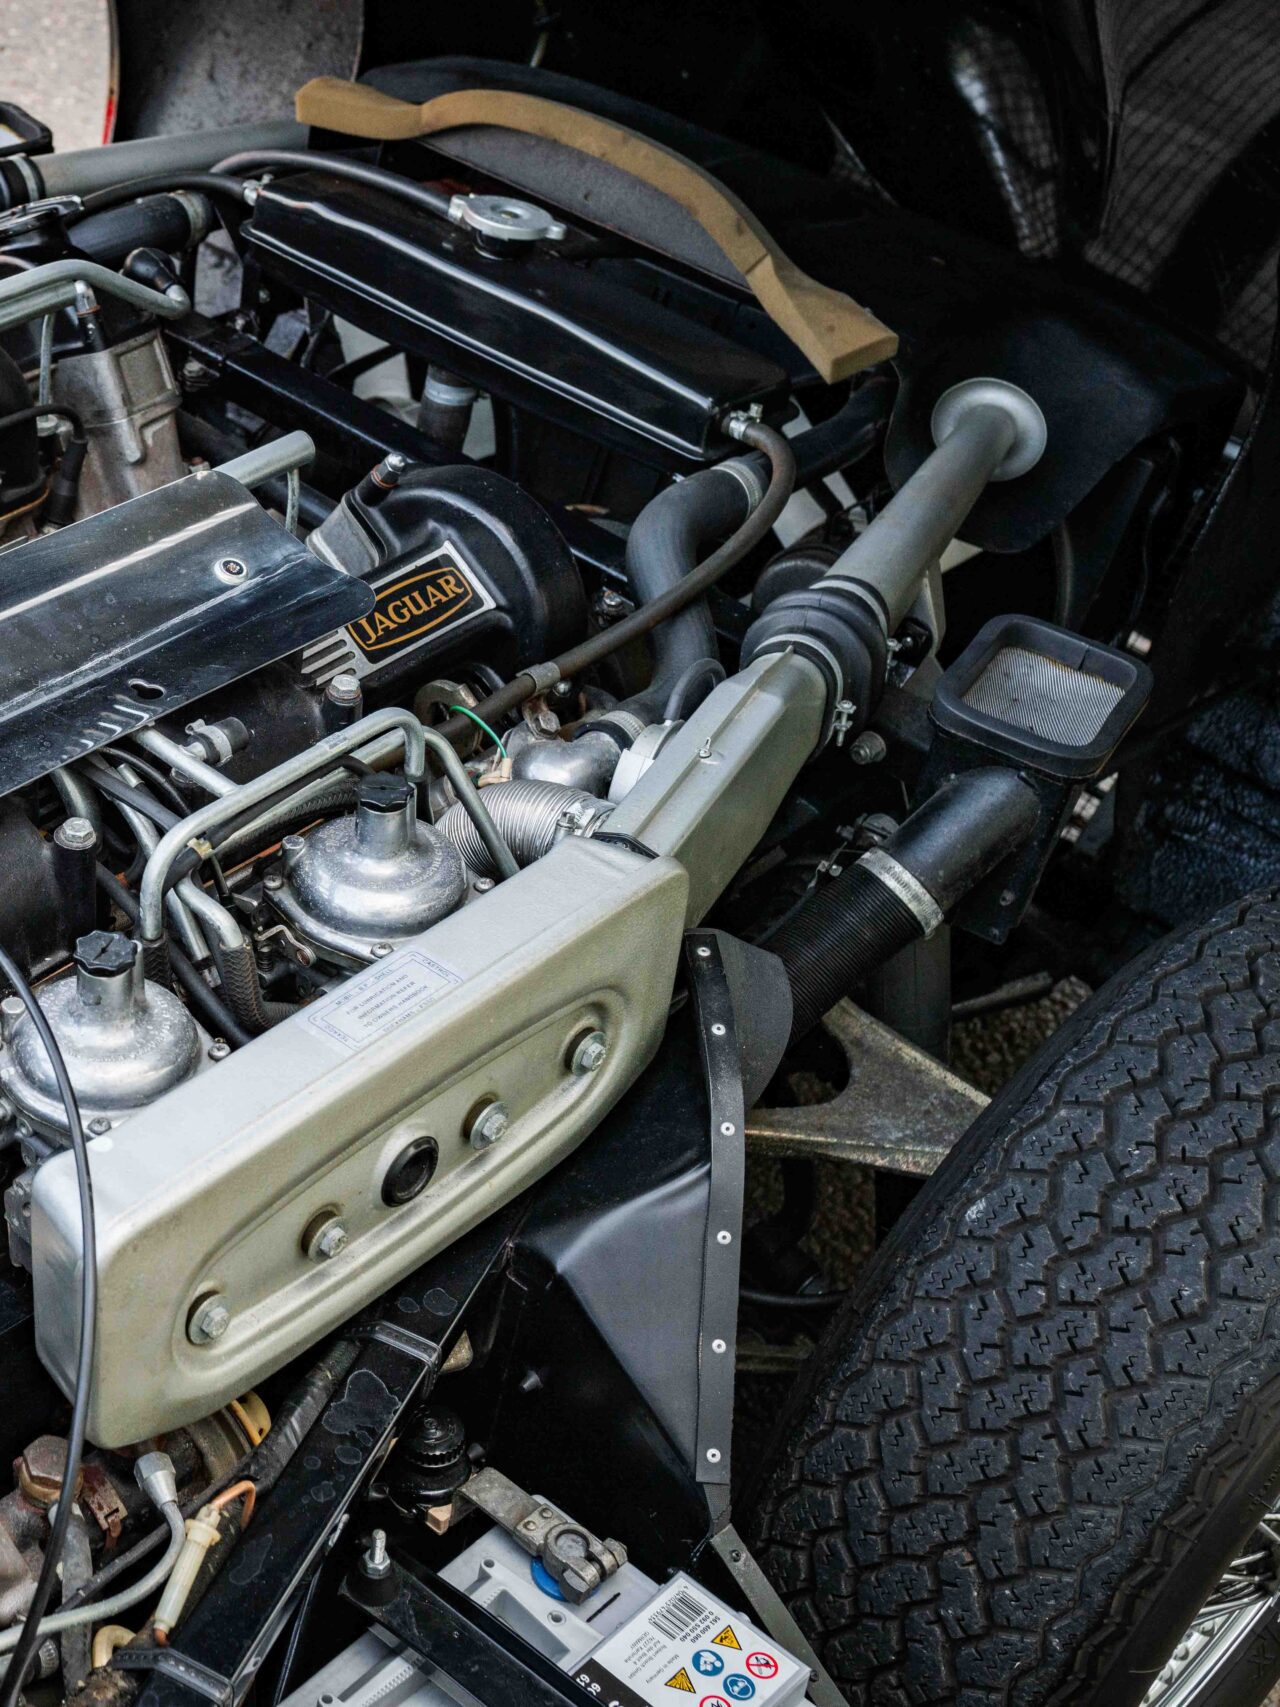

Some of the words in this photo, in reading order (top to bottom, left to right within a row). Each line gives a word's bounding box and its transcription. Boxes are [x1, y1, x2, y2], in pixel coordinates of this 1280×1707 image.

[359, 574, 464, 644] JAGUAR
[374, 968, 392, 980] SHELL
[422, 959, 450, 977] CASTROL
[346, 1006, 359, 1015] FOR
[359, 982, 397, 1007] LUBRICATION
[396, 974, 408, 983] AND
[358, 994, 396, 1019] INFORMATION
[396, 981, 416, 994] REFER
[398, 985, 428, 1006] HANDBOOK
[700, 1624, 710, 1634] 400
[710, 1616, 720, 1626] 561
[666, 1654, 680, 1664] Made
[646, 1666, 664, 1684] Germany
